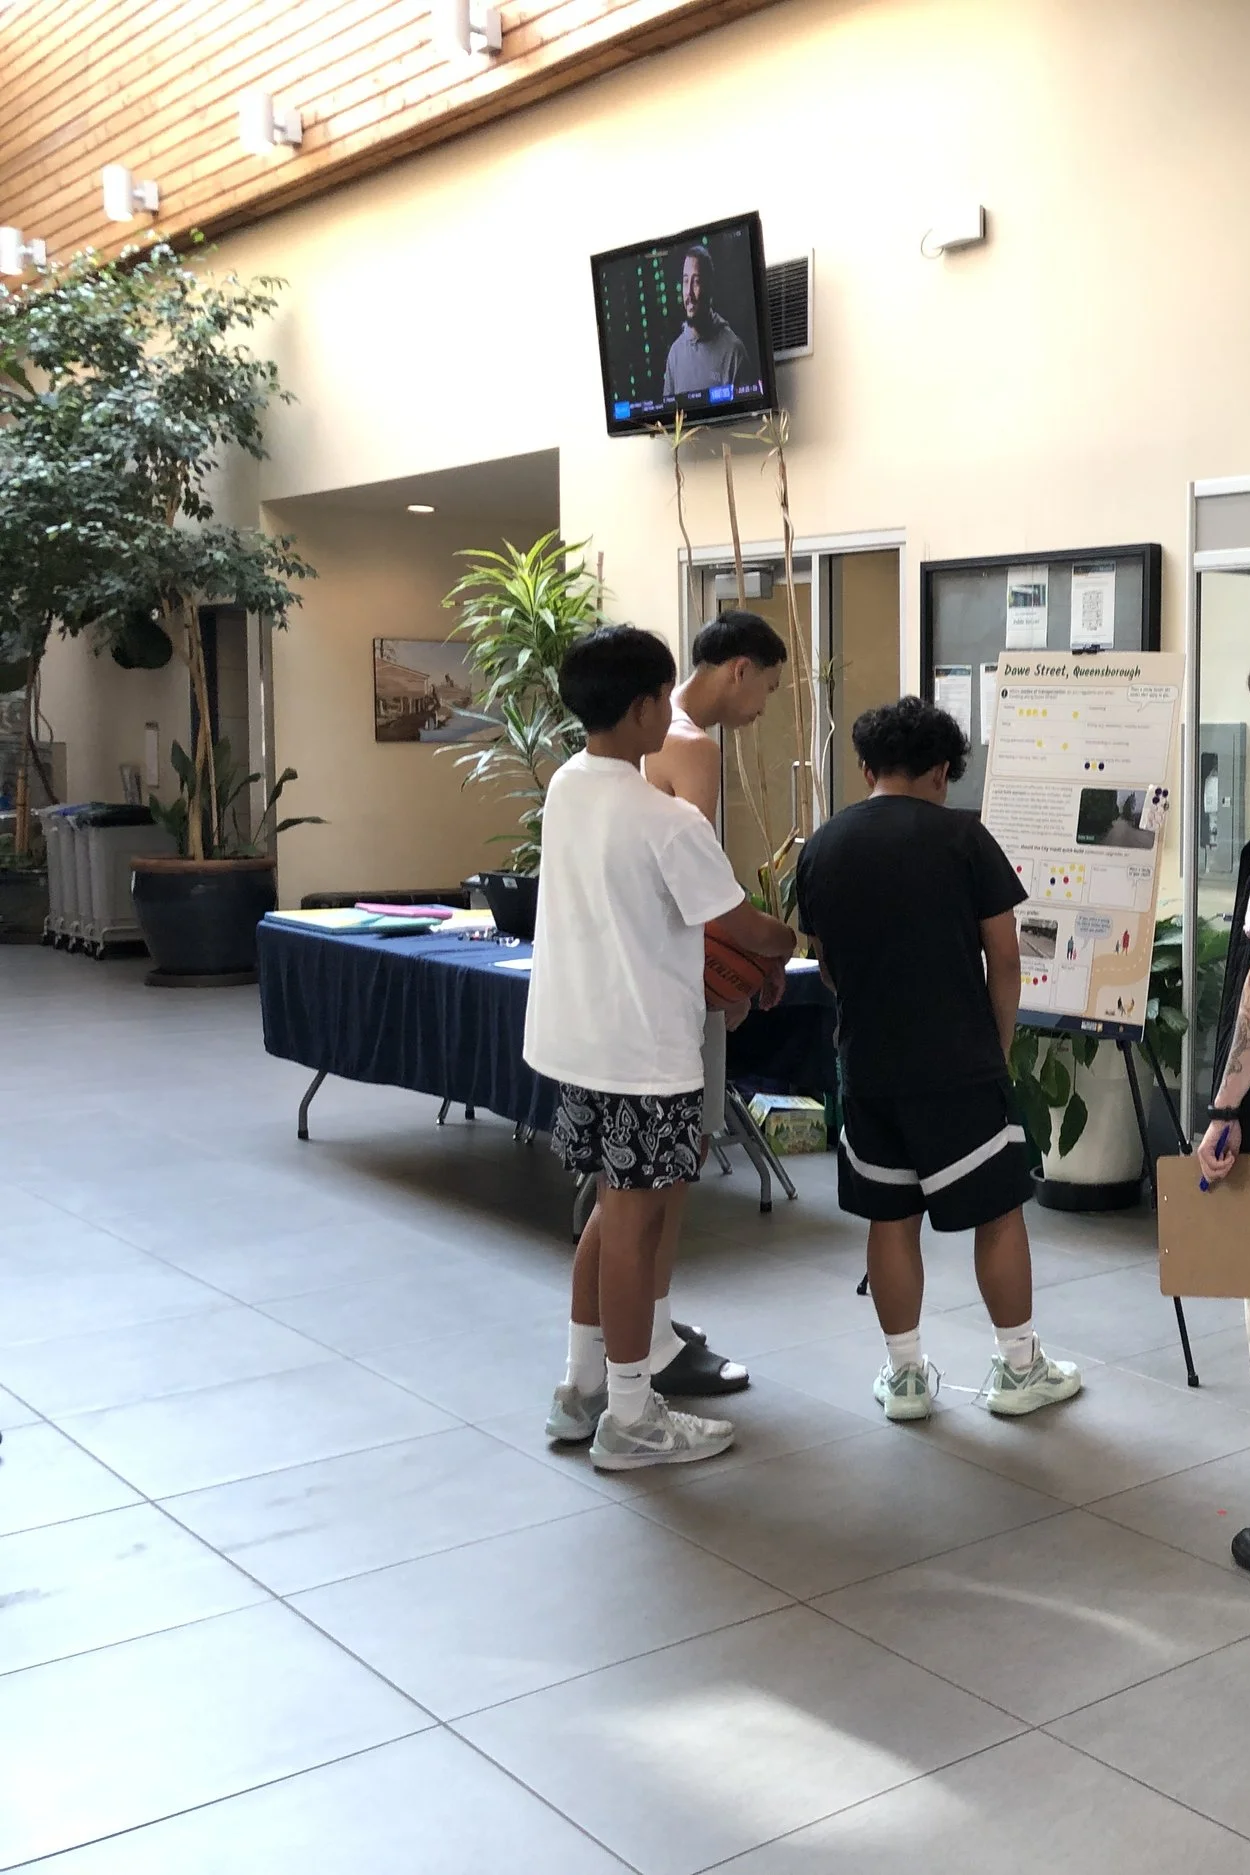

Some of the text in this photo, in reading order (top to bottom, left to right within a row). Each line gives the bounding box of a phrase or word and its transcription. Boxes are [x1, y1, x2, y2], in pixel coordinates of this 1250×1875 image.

[1005, 664, 1141, 680] Dawe Street, Queensborough
